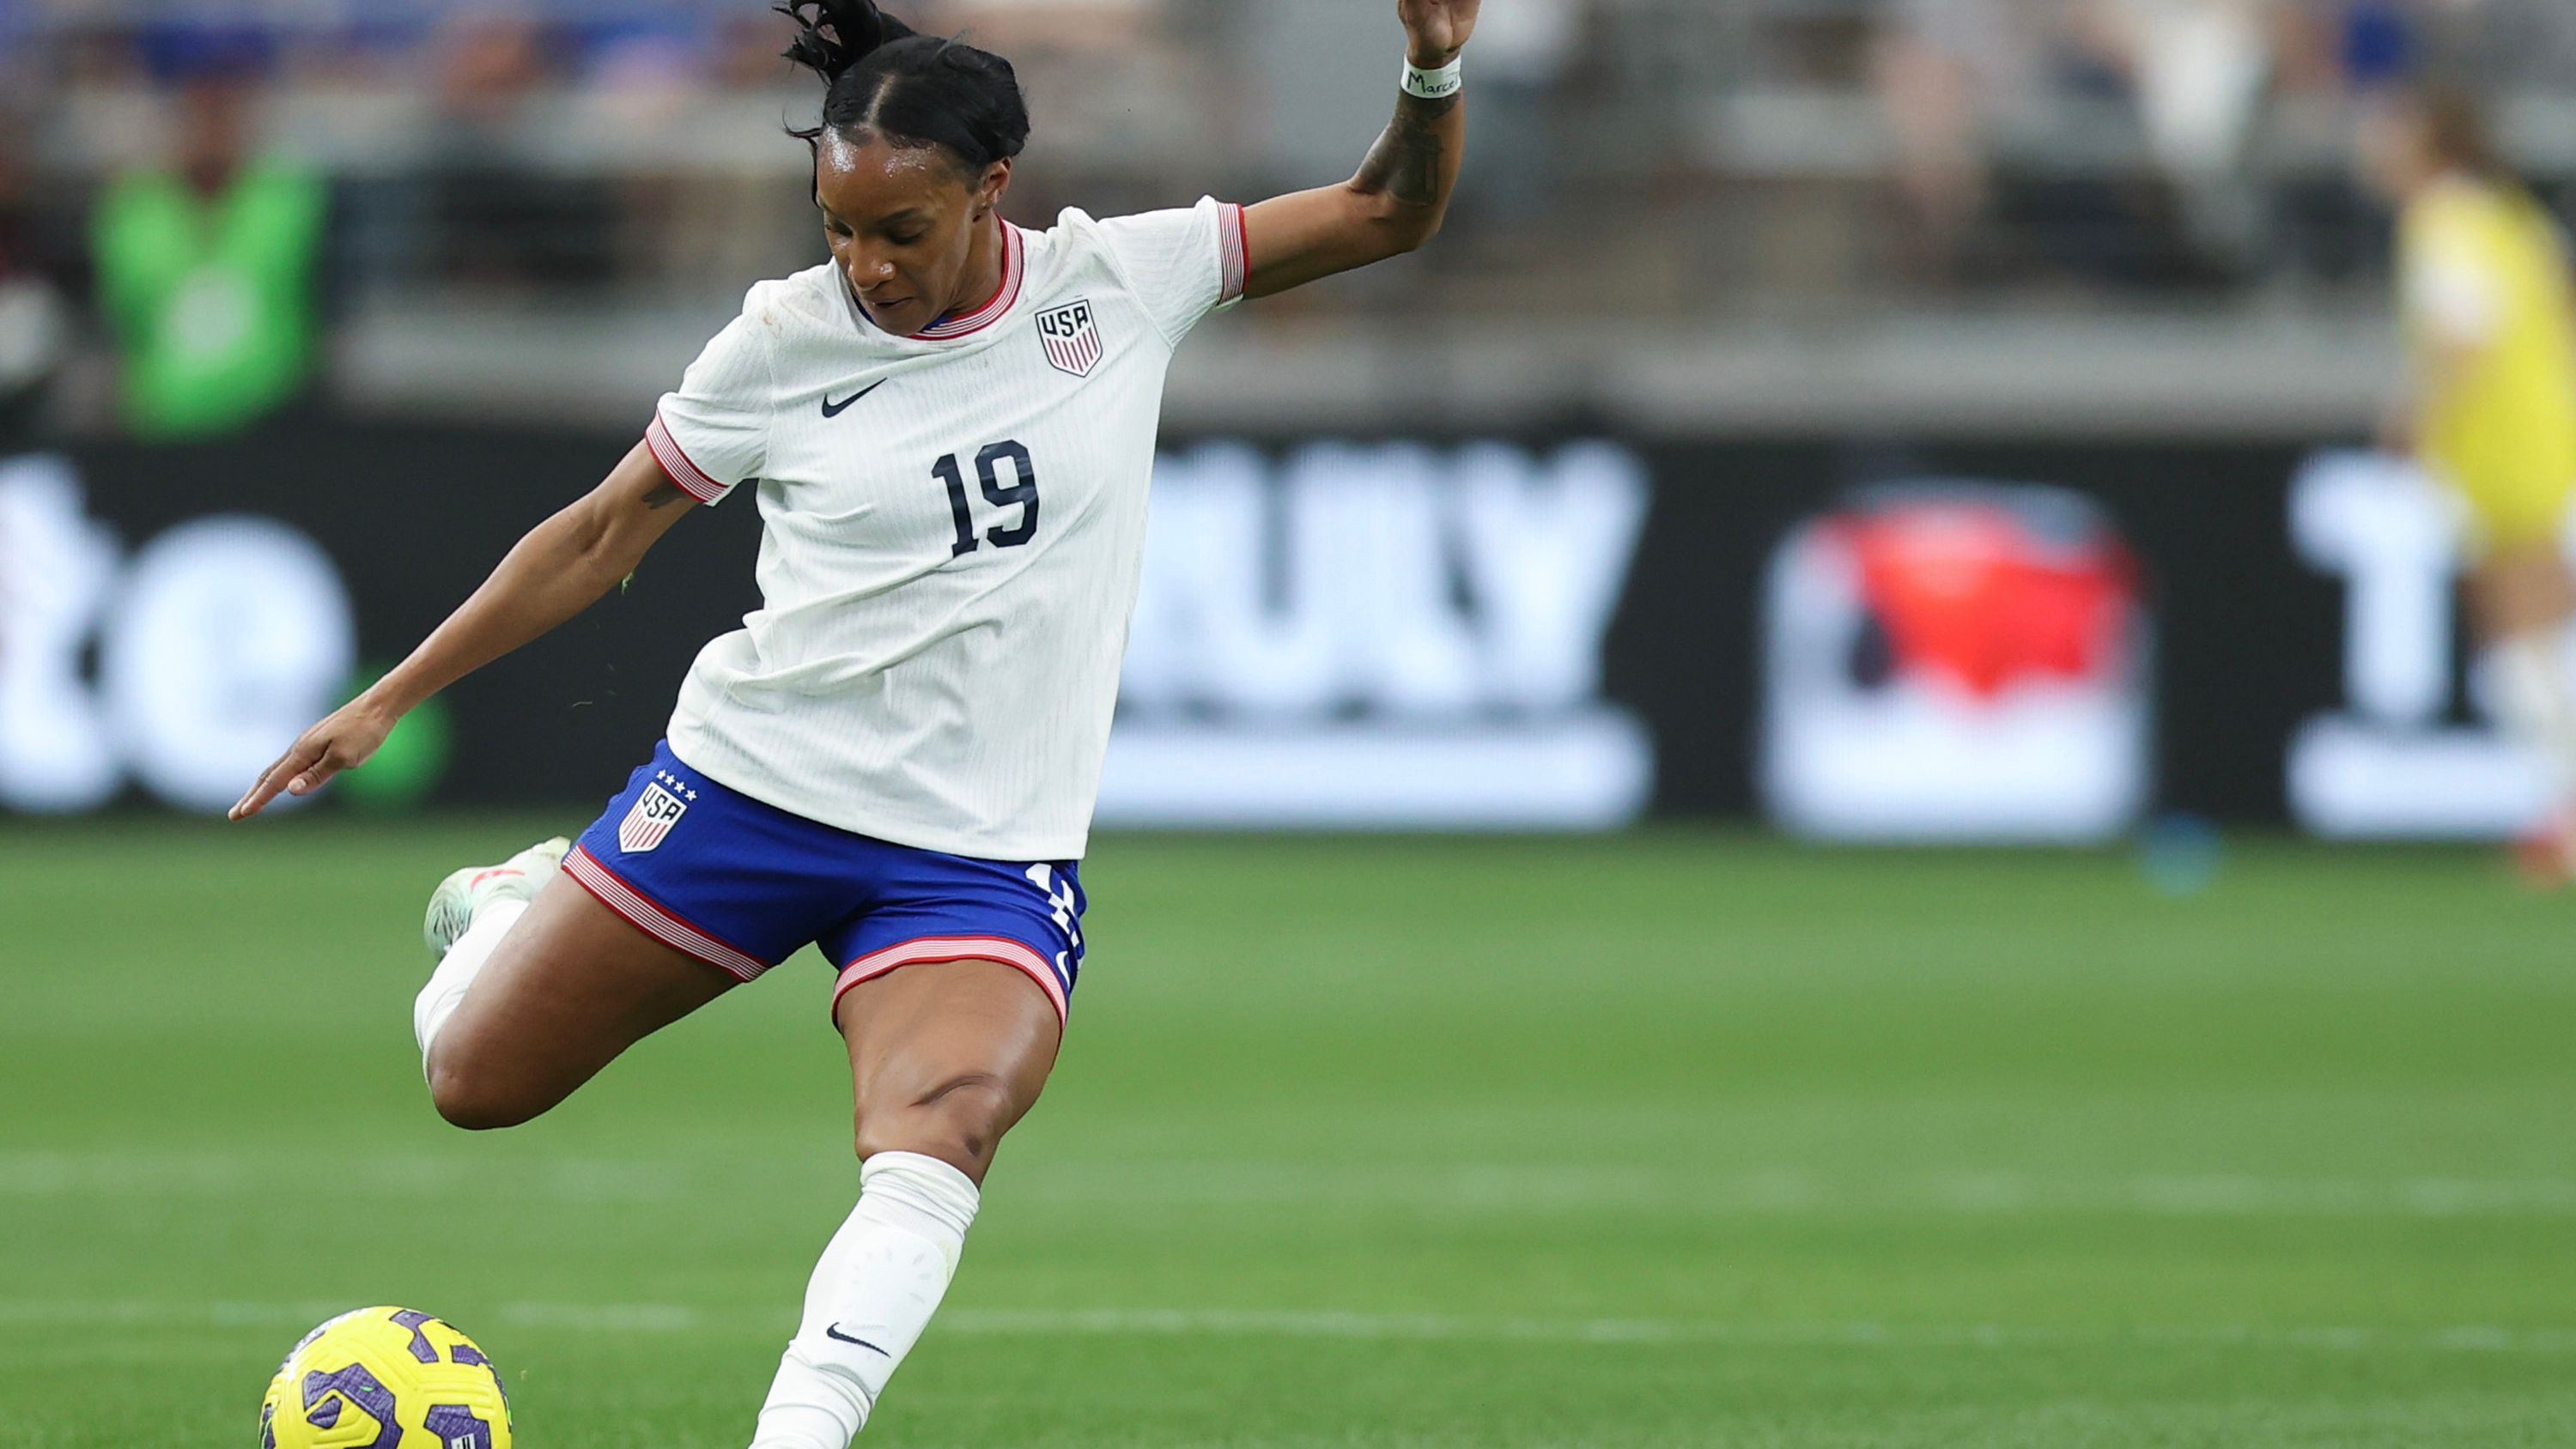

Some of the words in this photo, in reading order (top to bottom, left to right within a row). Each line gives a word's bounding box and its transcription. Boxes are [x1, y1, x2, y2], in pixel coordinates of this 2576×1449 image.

[1041, 306, 1089, 337] USA
[931, 440, 1040, 558] 19
[641, 785, 682, 821] USA
